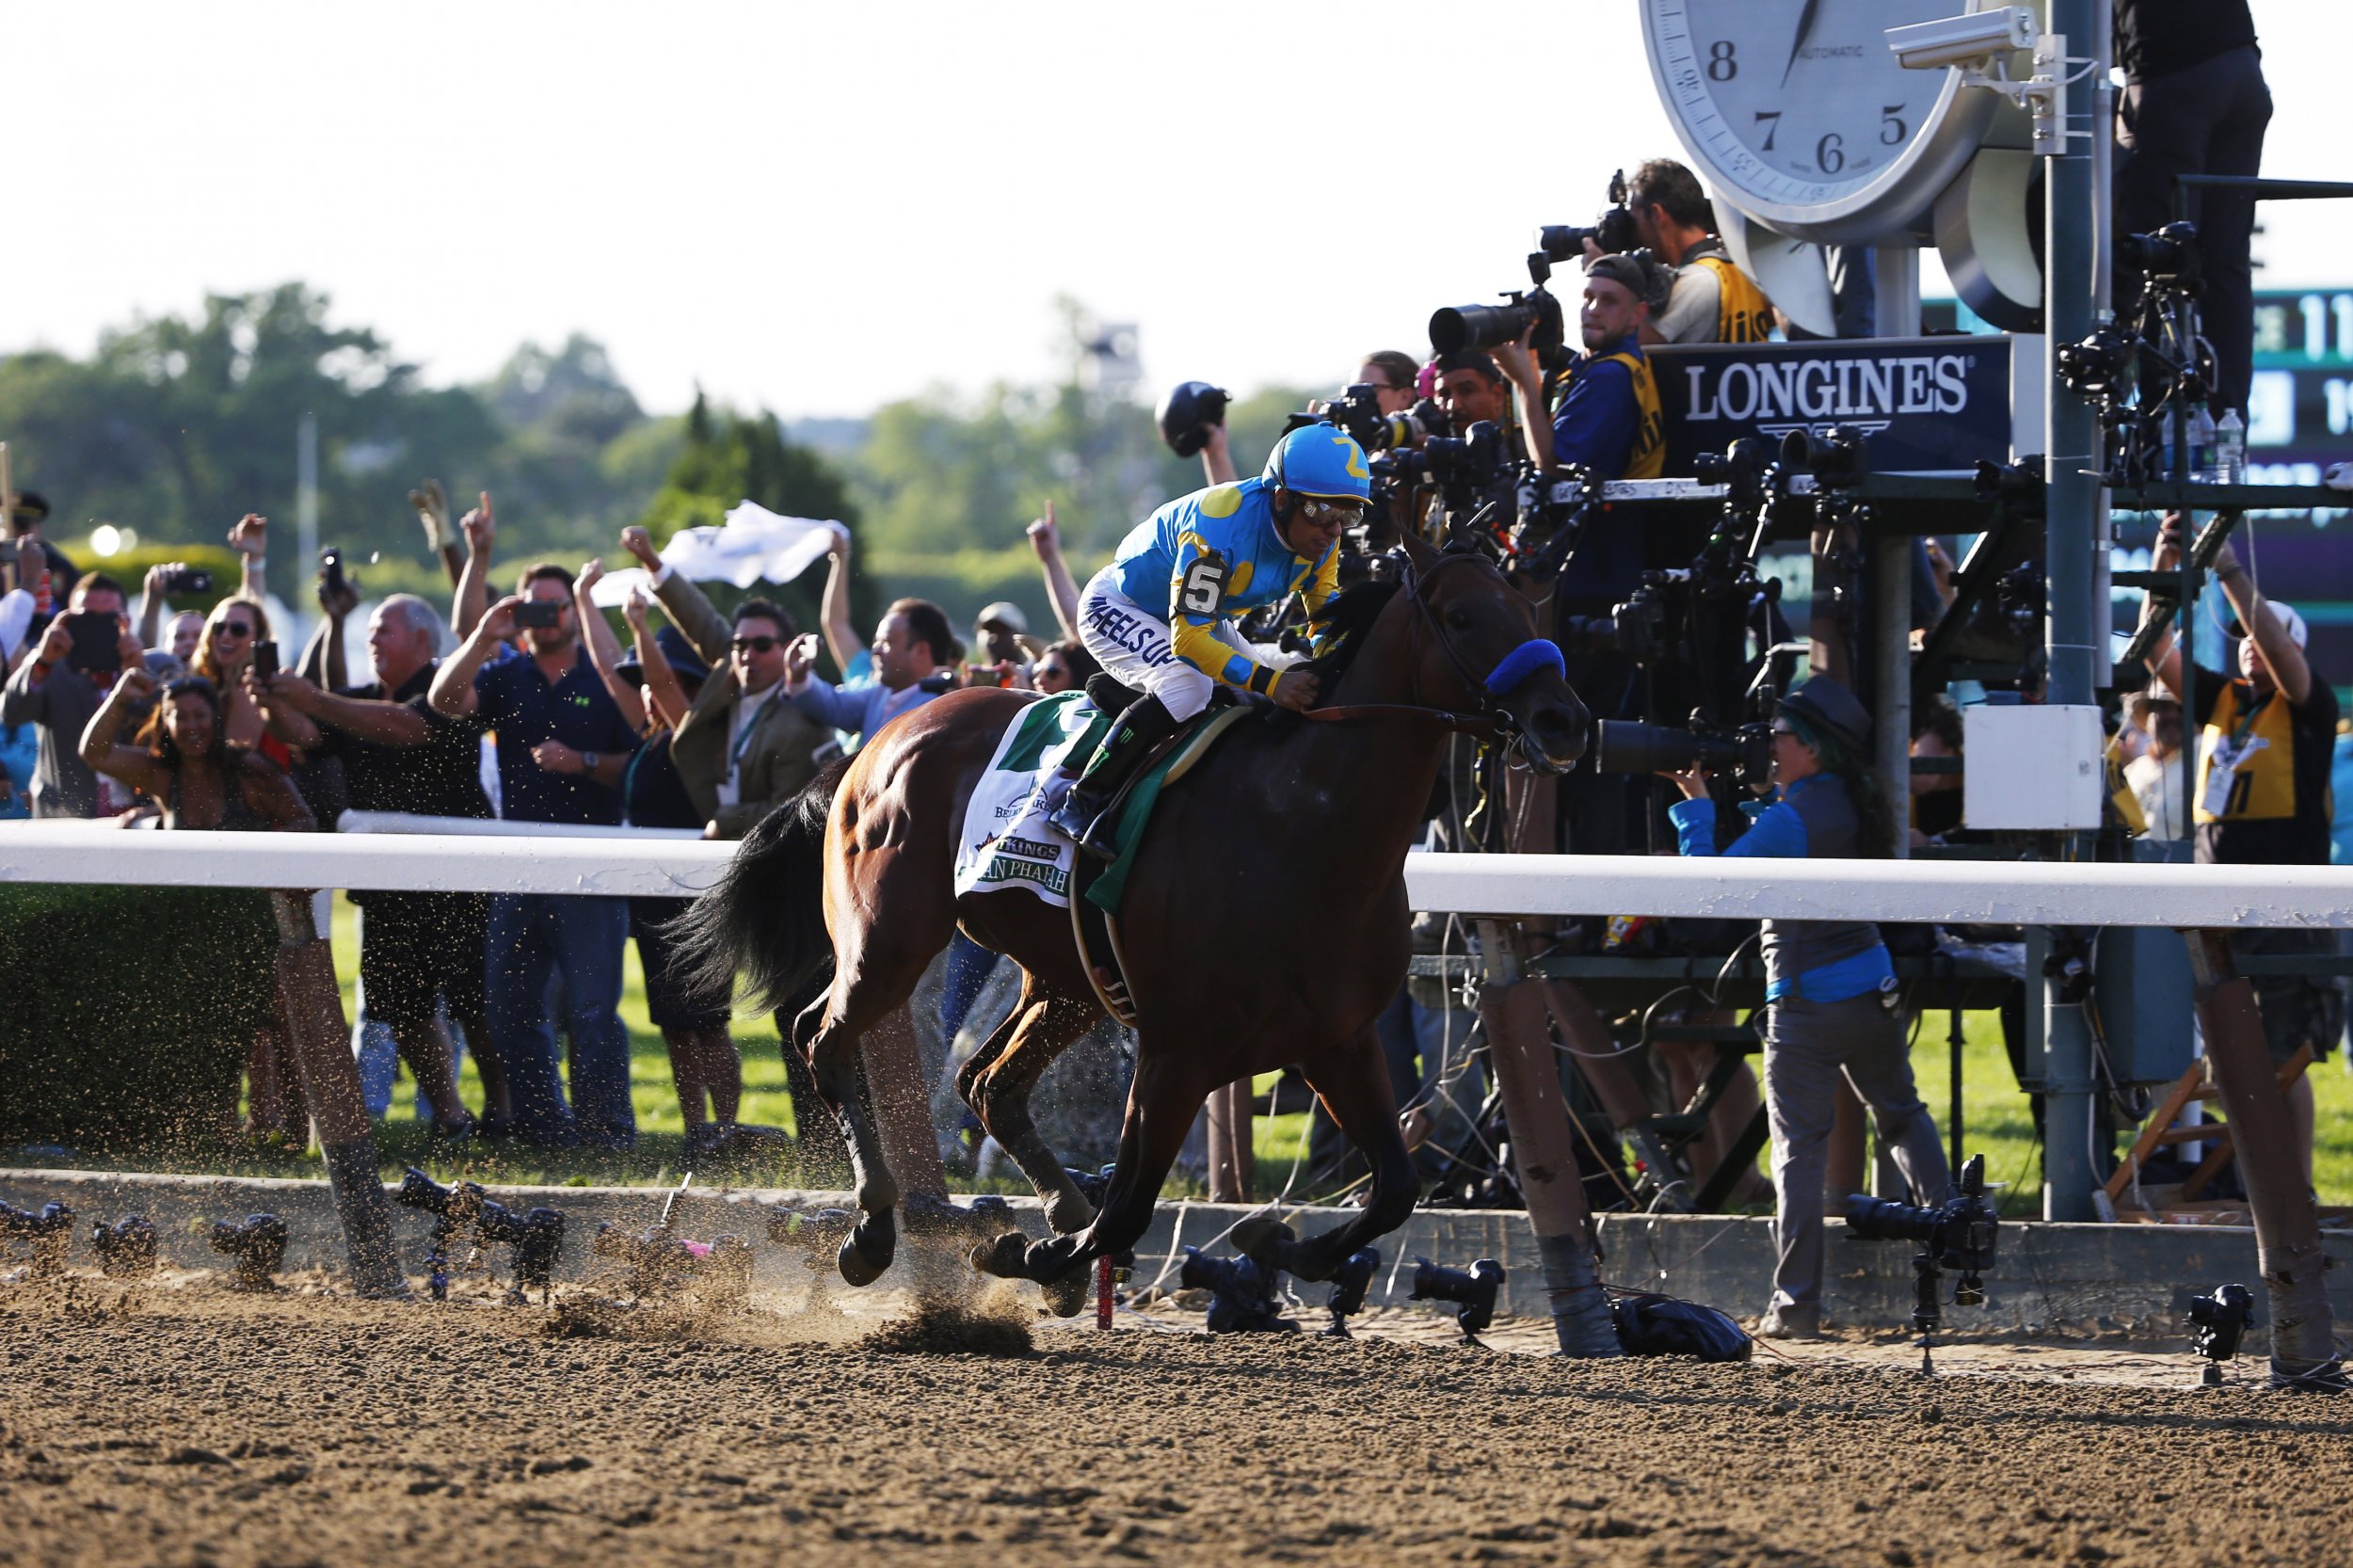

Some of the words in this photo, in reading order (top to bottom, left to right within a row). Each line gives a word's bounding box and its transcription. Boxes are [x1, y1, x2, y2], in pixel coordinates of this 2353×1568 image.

[1707, 40, 1737, 82] 8
[1754, 111, 1783, 152] 7
[1881, 104, 1907, 145] 5
[1817, 133, 1844, 174] 6
[1685, 354, 1968, 421] LONGINES
[1185, 565, 1223, 613] 5
